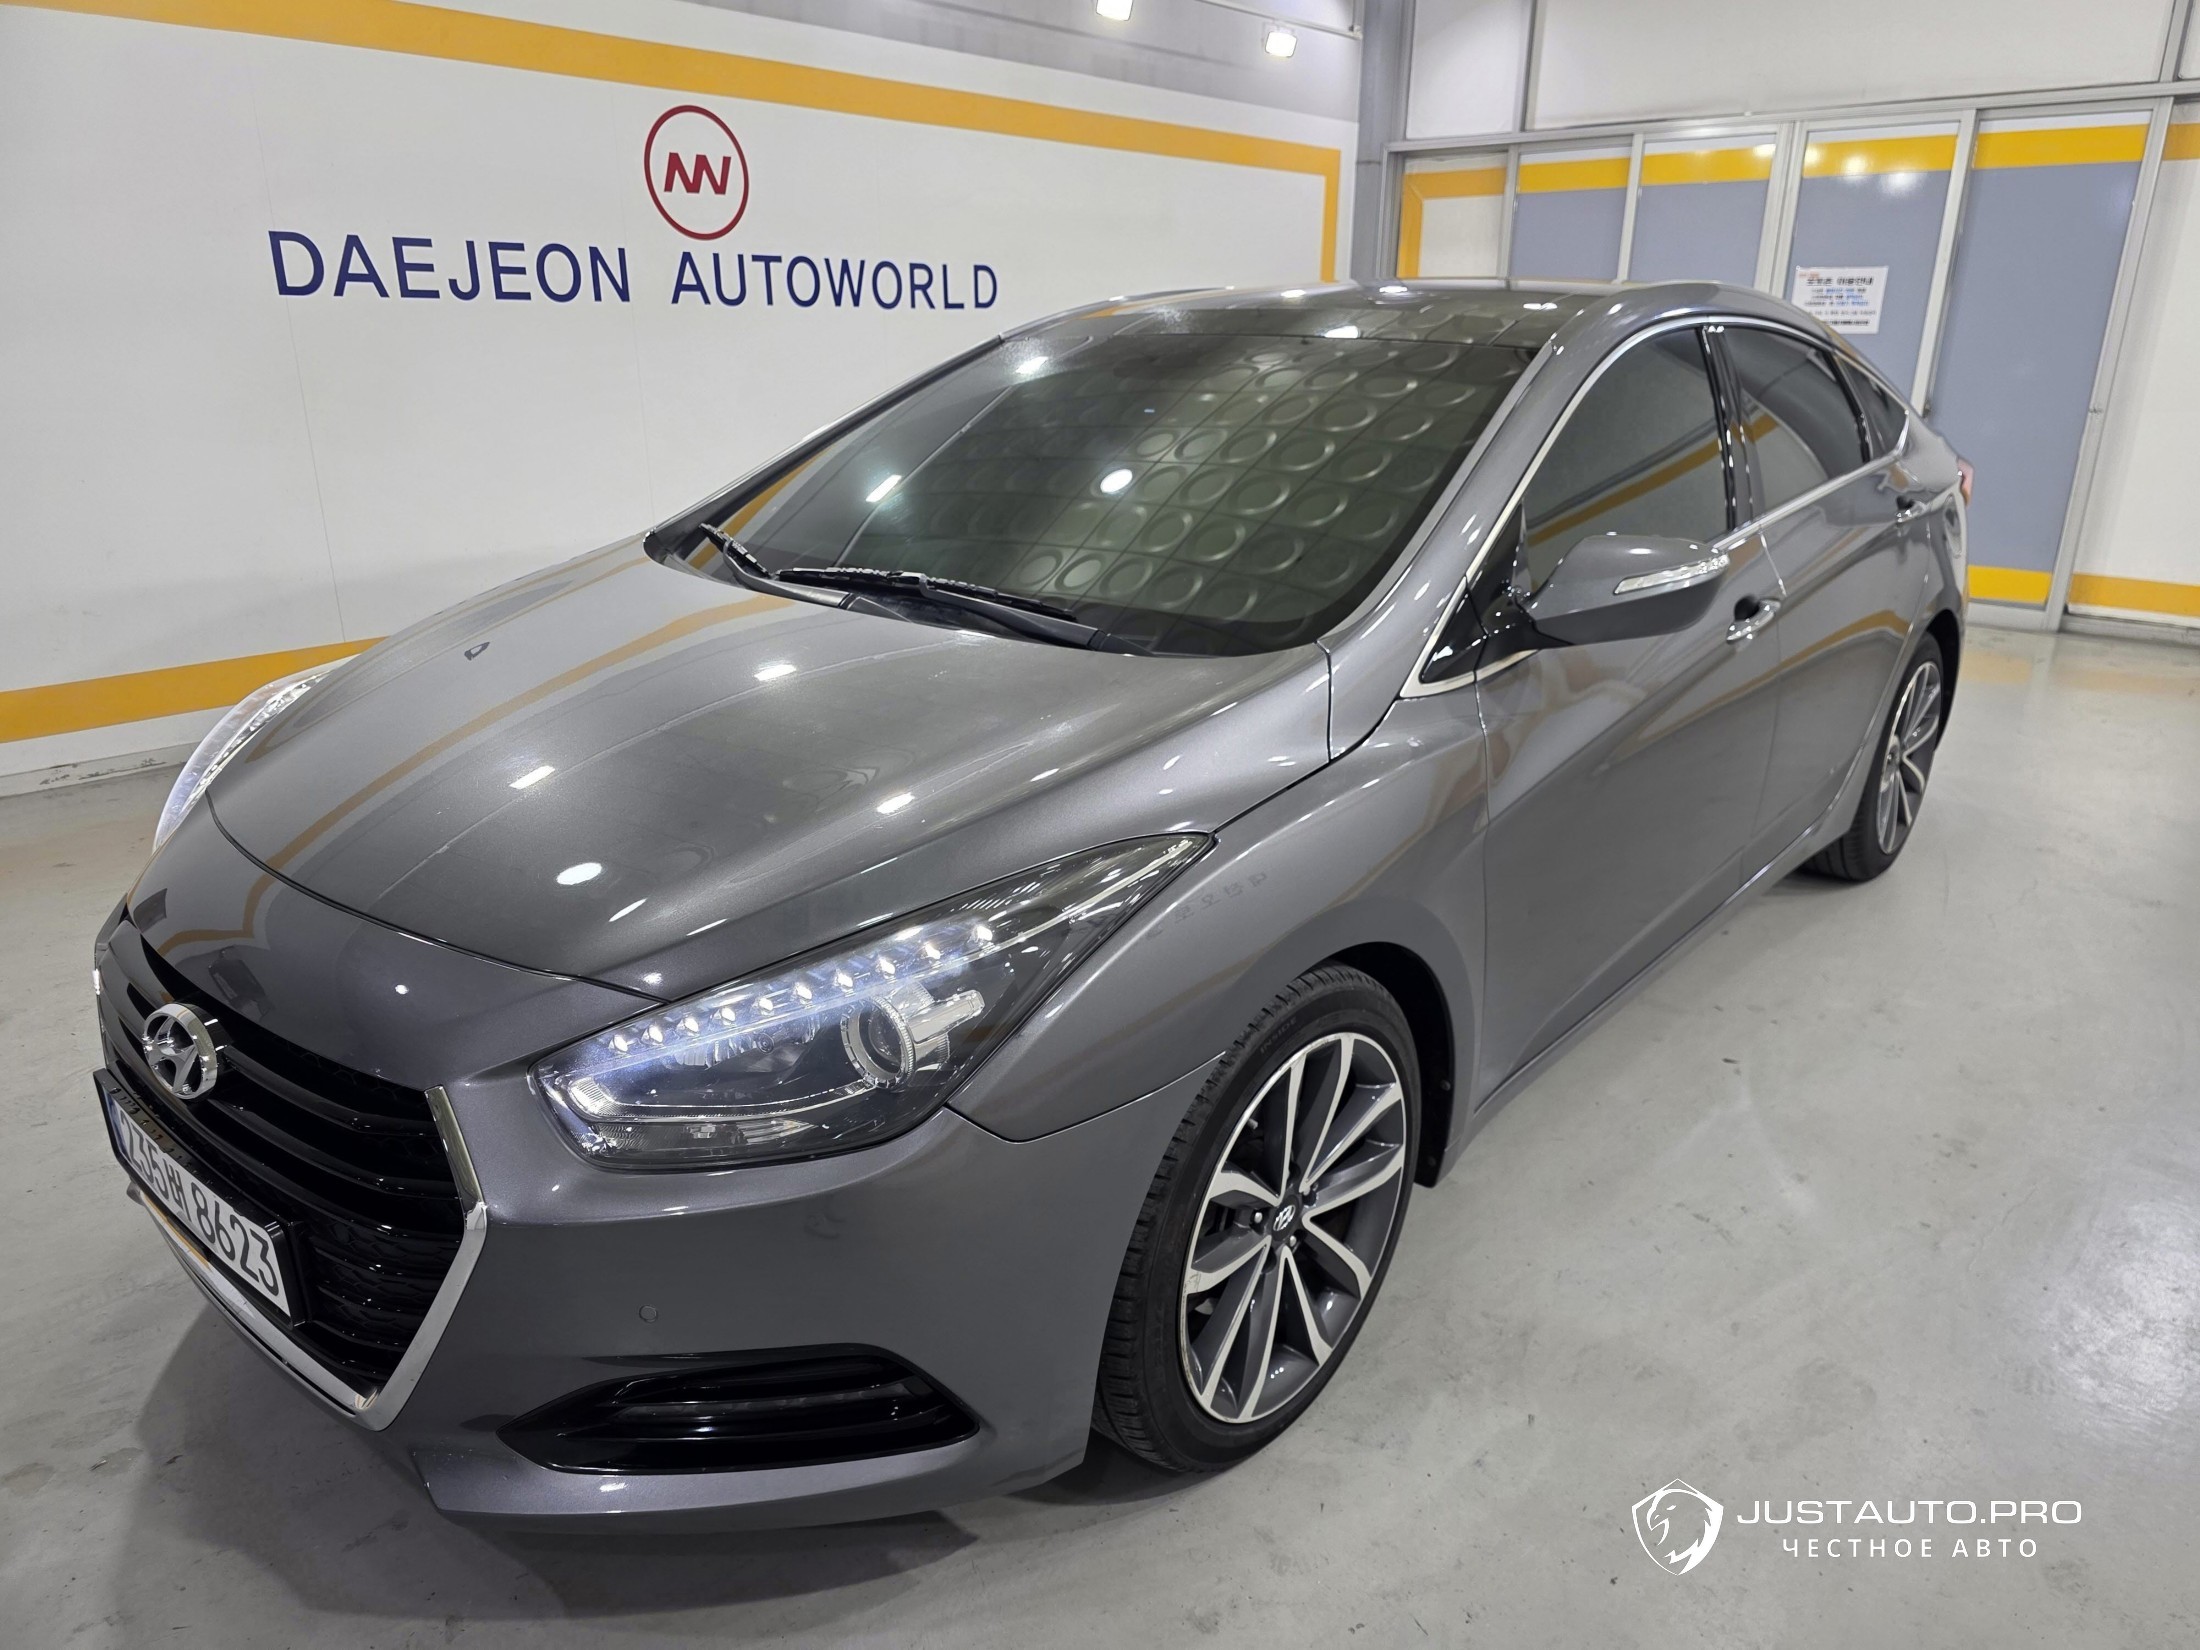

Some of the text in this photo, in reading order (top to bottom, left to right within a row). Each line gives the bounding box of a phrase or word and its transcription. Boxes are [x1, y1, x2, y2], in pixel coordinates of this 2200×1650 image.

[268, 230, 998, 310] DAEJEON AUTOWORLD
[191, 1183, 279, 1297] 8623
